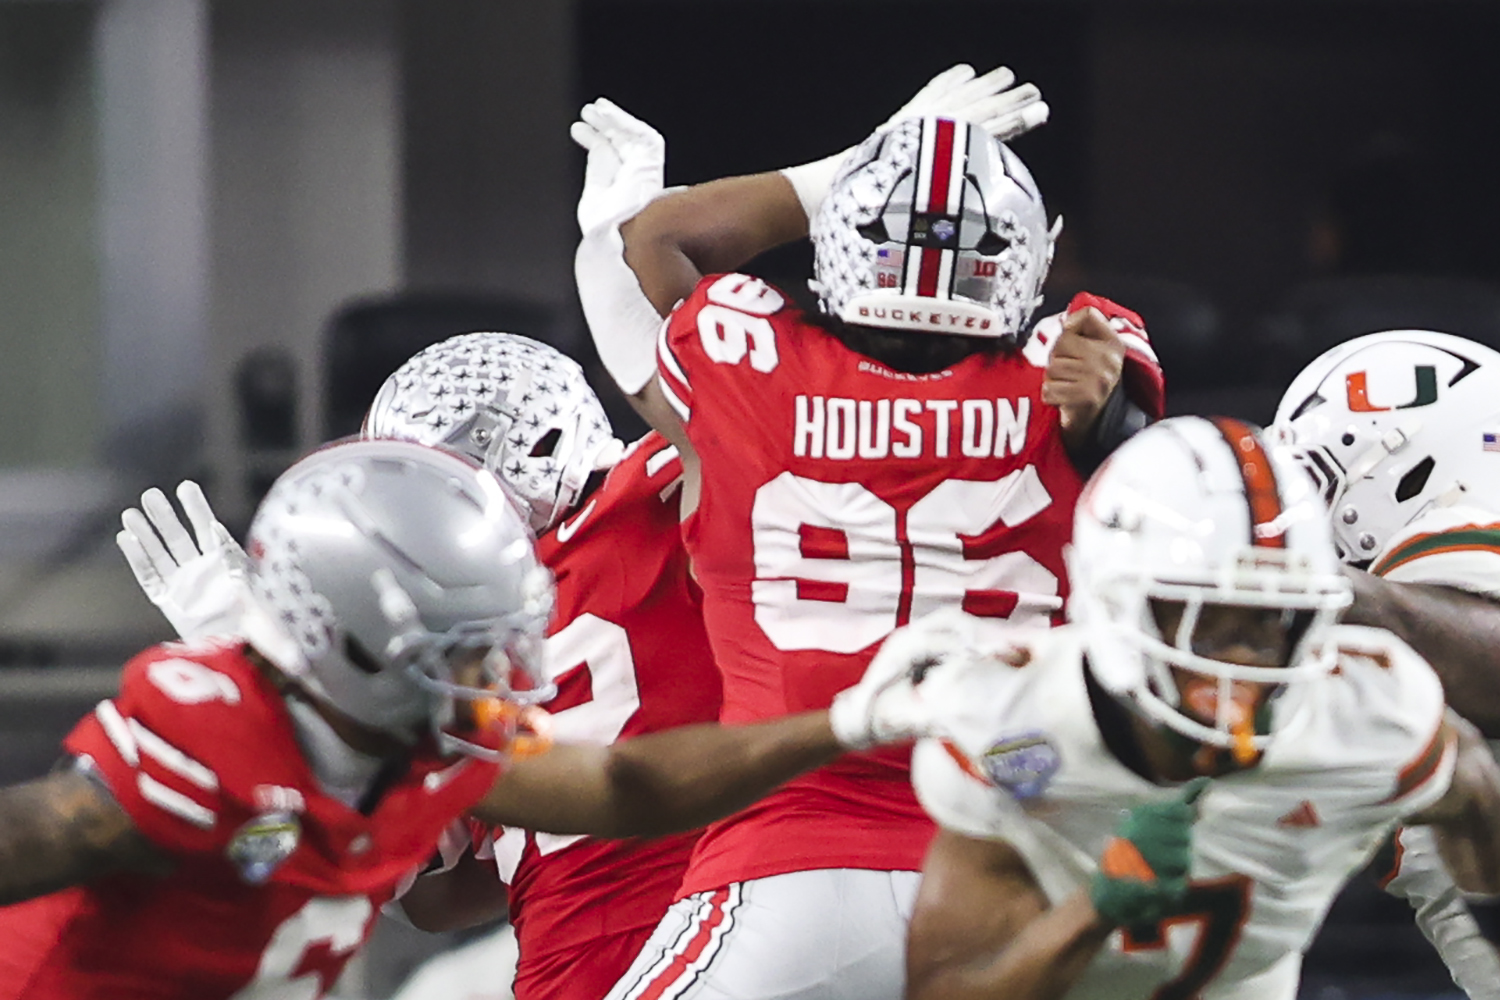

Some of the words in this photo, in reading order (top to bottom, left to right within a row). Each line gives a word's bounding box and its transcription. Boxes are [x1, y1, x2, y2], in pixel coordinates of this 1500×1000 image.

[859, 306, 992, 330] BUCKEYES
[1346, 365, 1438, 412] U
[794, 395, 1031, 461] HOUSTON
[751, 463, 1066, 653] 96
